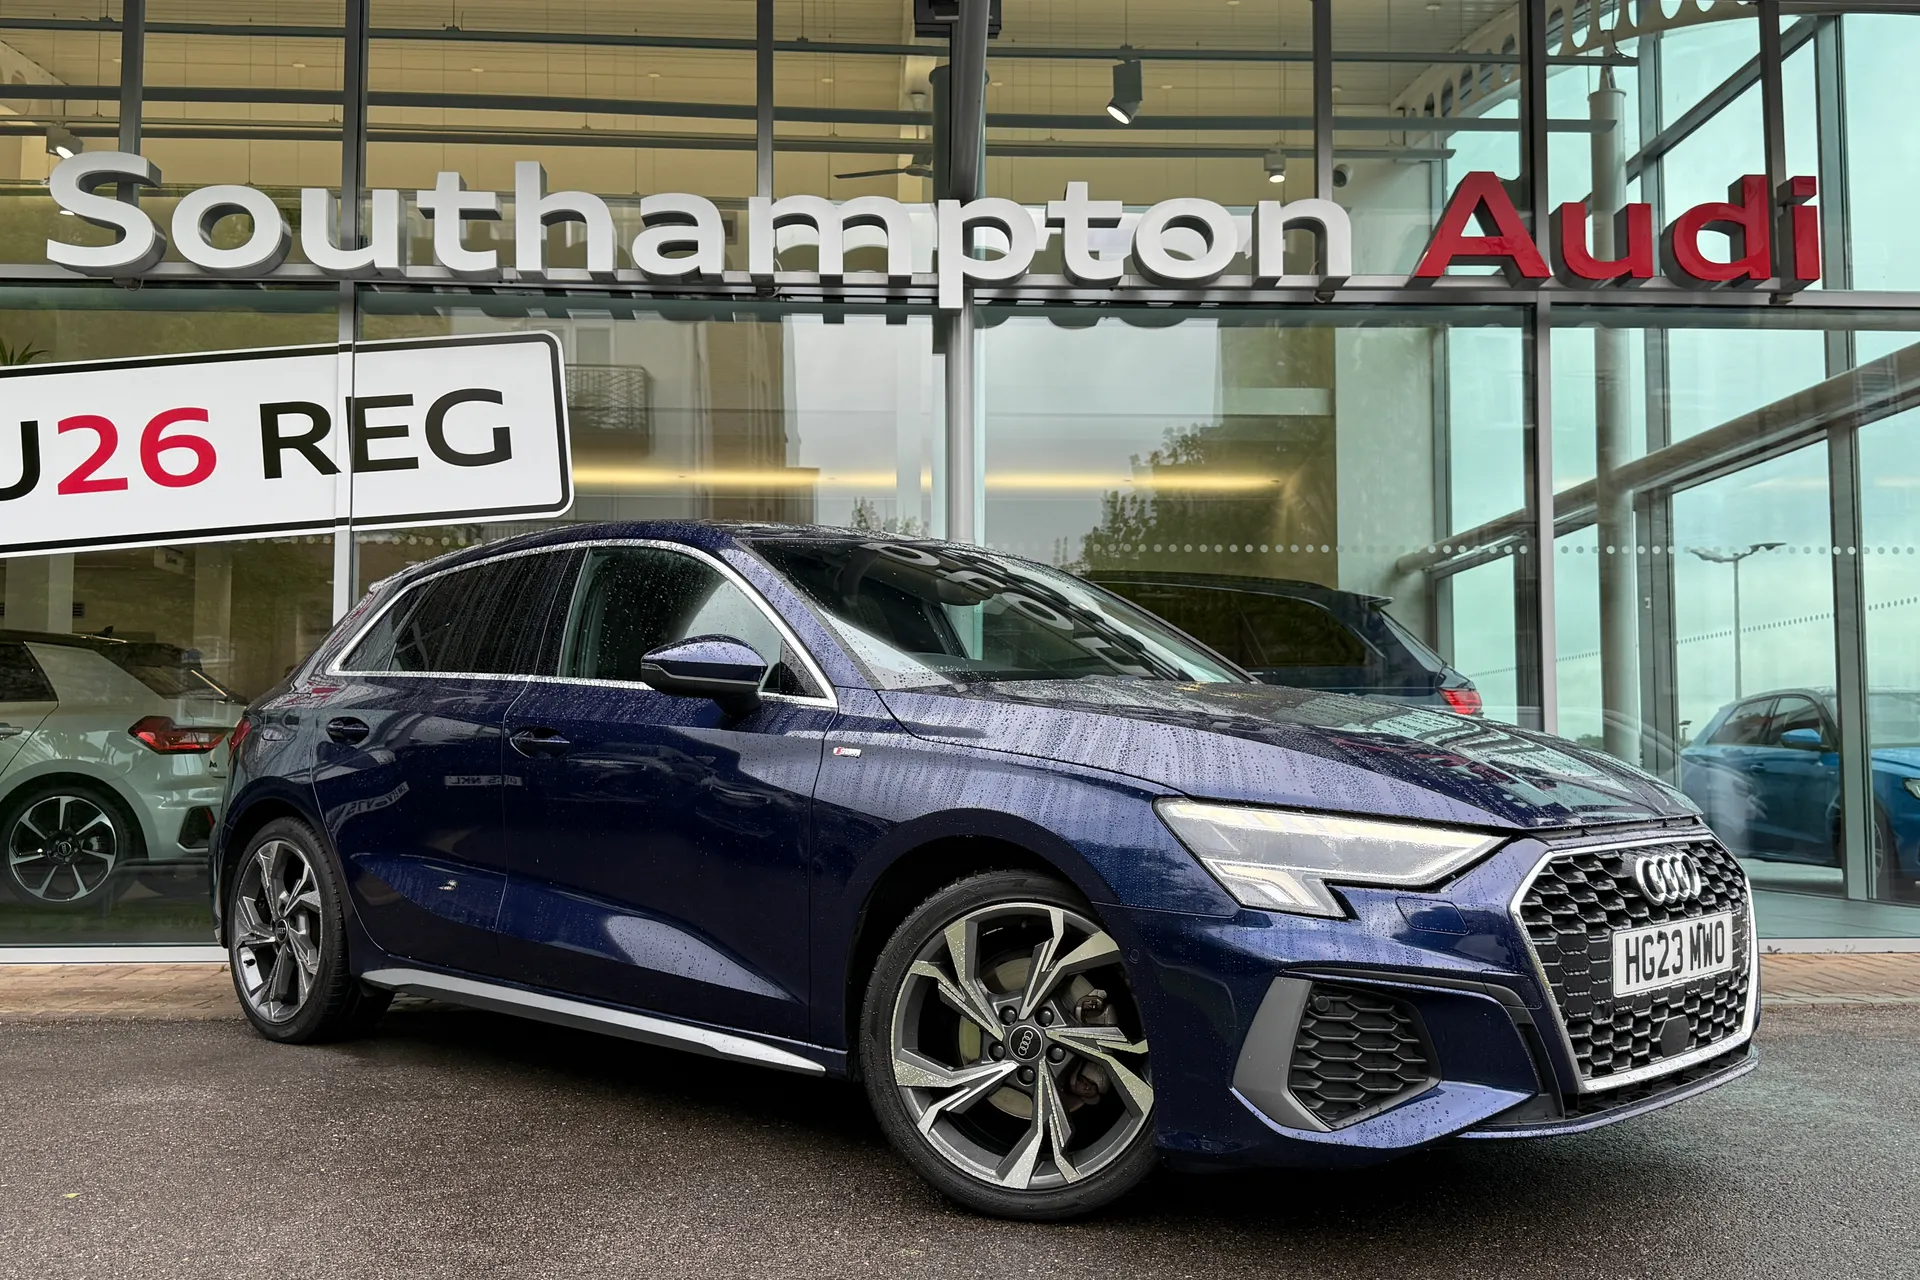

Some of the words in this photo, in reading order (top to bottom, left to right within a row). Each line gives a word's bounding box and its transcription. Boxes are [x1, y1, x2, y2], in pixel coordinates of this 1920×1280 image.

[47, 151, 1353, 309] Southampton
[1411, 170, 1822, 288] Audi
[259, 388, 512, 480] REG
[1625, 929, 1684, 985] HG23
[1689, 920, 1725, 971] MWO
